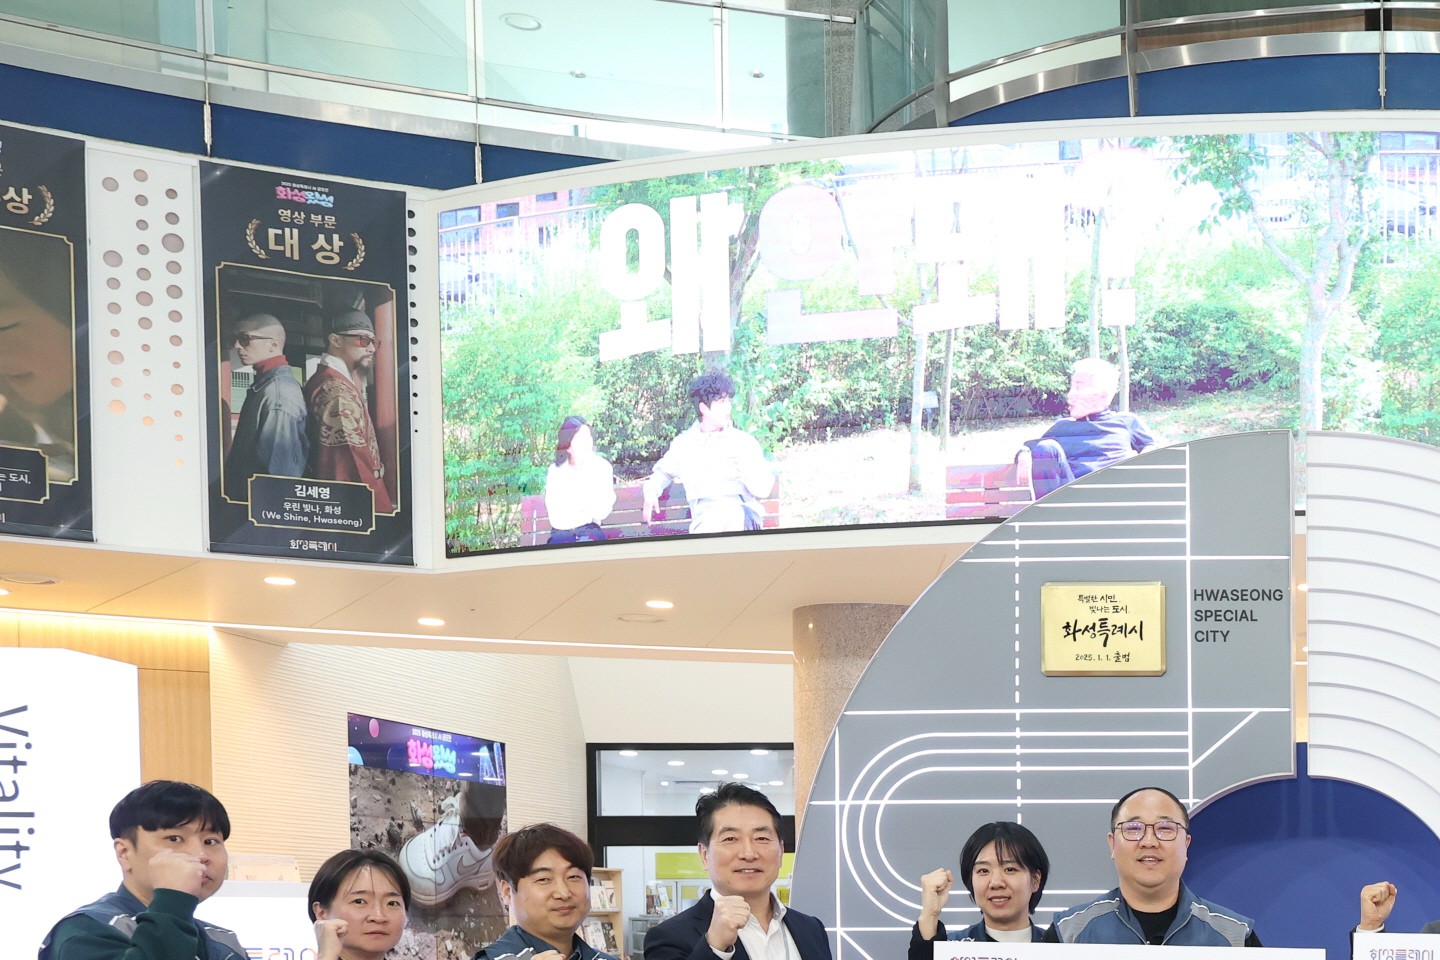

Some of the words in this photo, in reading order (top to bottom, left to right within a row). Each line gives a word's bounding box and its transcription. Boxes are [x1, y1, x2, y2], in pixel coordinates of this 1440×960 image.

[278, 208, 306, 225] 영상
[310, 213, 337, 229] 부문
[268, 227, 300, 260] 대
[311, 233, 344, 265] 상
[294, 484, 331, 499] 김세영
[283, 502, 300, 512] 우린
[302, 503, 322, 514] 빛나,
[324, 505, 341, 515] 화성
[262, 511, 281, 520] (We
[283, 513, 311, 524] Shine,
[313, 515, 363, 528] Hwaseong)
[289, 539, 338, 552] 화성특례시
[1077, 594, 1098, 603] 특별한
[1193, 588, 1284, 602] HWASEONG
[1089, 605, 1110, 614] 빛나는
[1194, 609, 1258, 622] SPECIAL
[1062, 617, 1144, 648] 화성특례시
[1194, 629, 1230, 643] CITY
[1113, 650, 1130, 663] 출범
